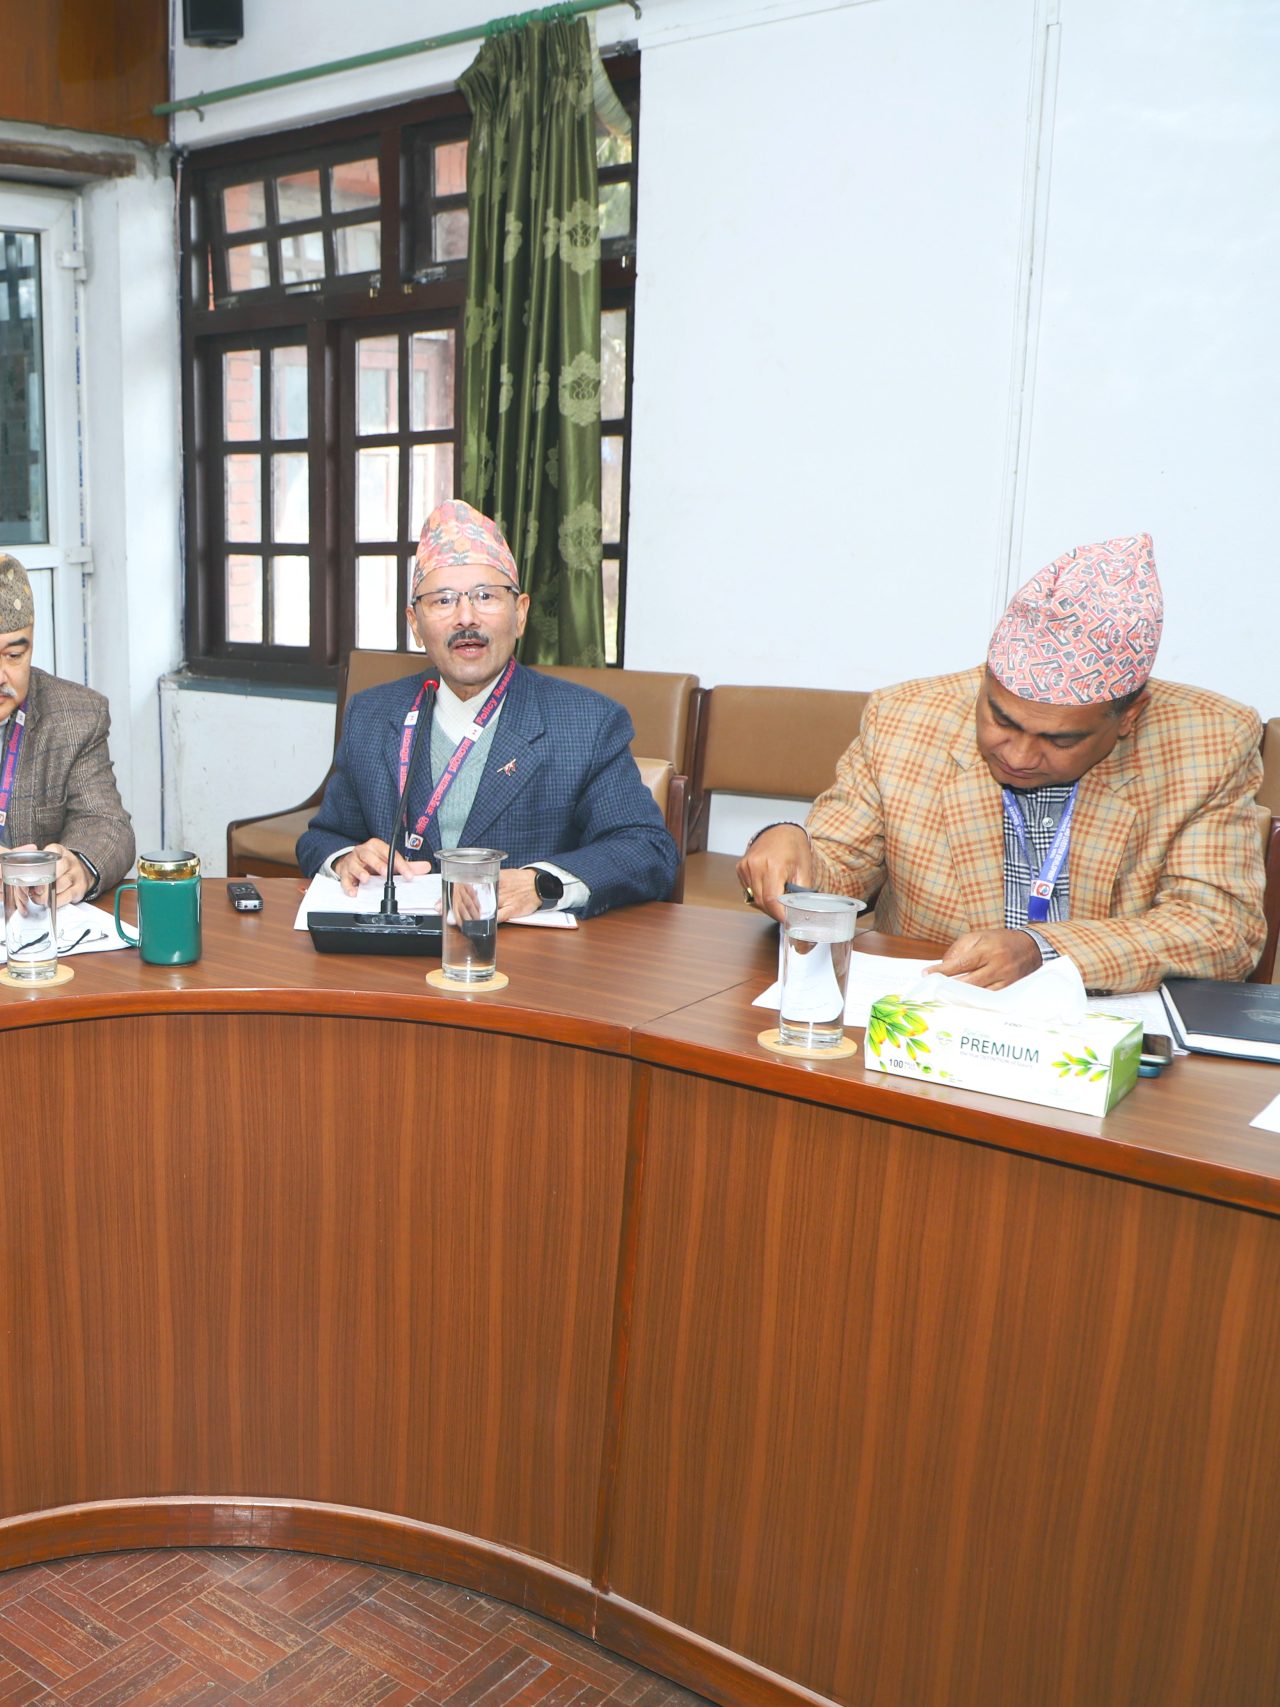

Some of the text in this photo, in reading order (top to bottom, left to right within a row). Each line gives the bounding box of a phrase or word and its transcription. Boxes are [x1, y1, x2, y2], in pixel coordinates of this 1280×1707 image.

[475, 697, 497, 725] Policy
[889, 1058, 904, 1068] 100
[959, 1036, 1039, 1063] PREMIUM
